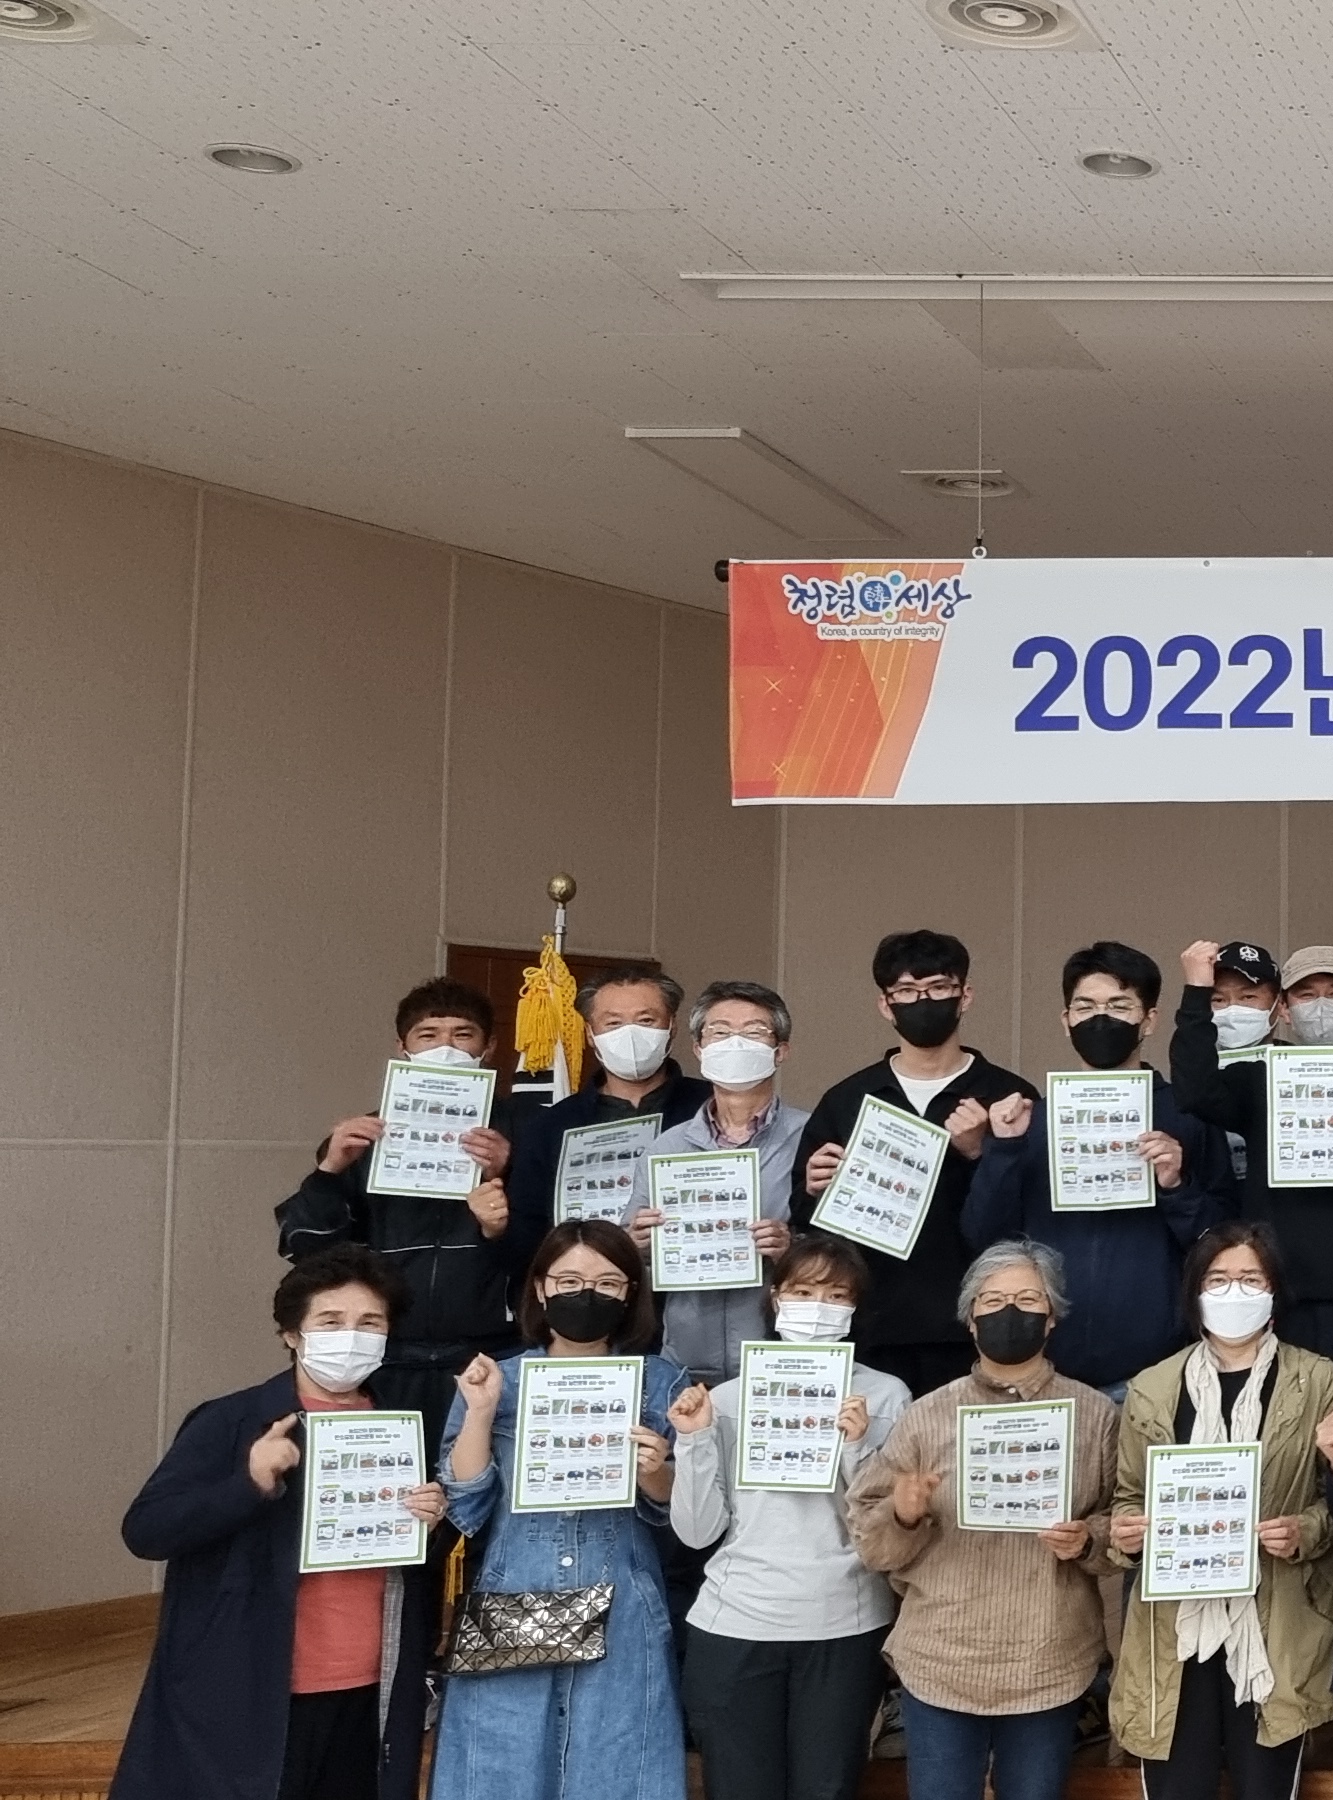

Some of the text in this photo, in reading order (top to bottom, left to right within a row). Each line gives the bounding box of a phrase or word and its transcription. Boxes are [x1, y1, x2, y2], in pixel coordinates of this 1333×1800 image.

[821, 626, 849, 638] Korea,
[860, 627, 892, 638] country
[894, 626, 903, 636] of
[904, 625, 940, 638] integrity
